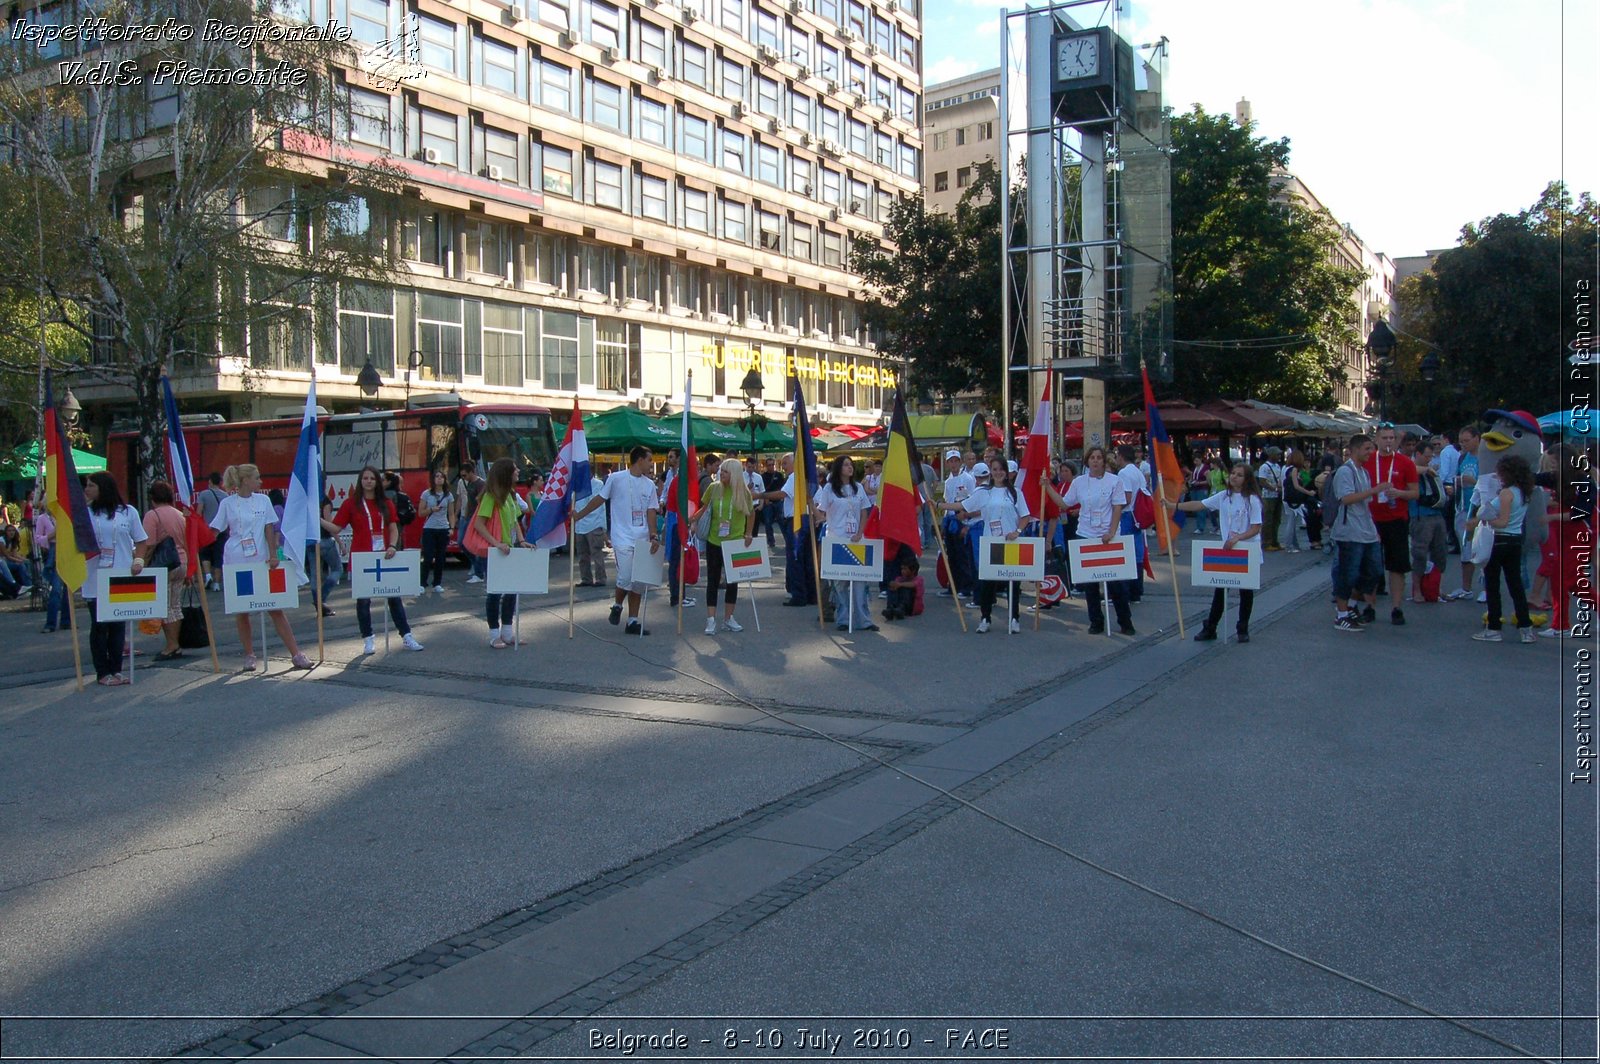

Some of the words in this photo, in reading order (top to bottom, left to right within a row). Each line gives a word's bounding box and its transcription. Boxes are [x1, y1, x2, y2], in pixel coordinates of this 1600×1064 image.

[702, 344, 775, 376] KULTURNI
[779, 354, 830, 381] CENTAR
[833, 358, 896, 389] BEOGRADA
[739, 570, 760, 579] Bulgaria
[997, 570, 1026, 578] Belgium
[1091, 570, 1117, 579] Austria
[1210, 577, 1241, 586] Armenia
[373, 586, 401, 594] Finland
[249, 600, 276, 609] France
[113, 608, 147, 617] Germany
